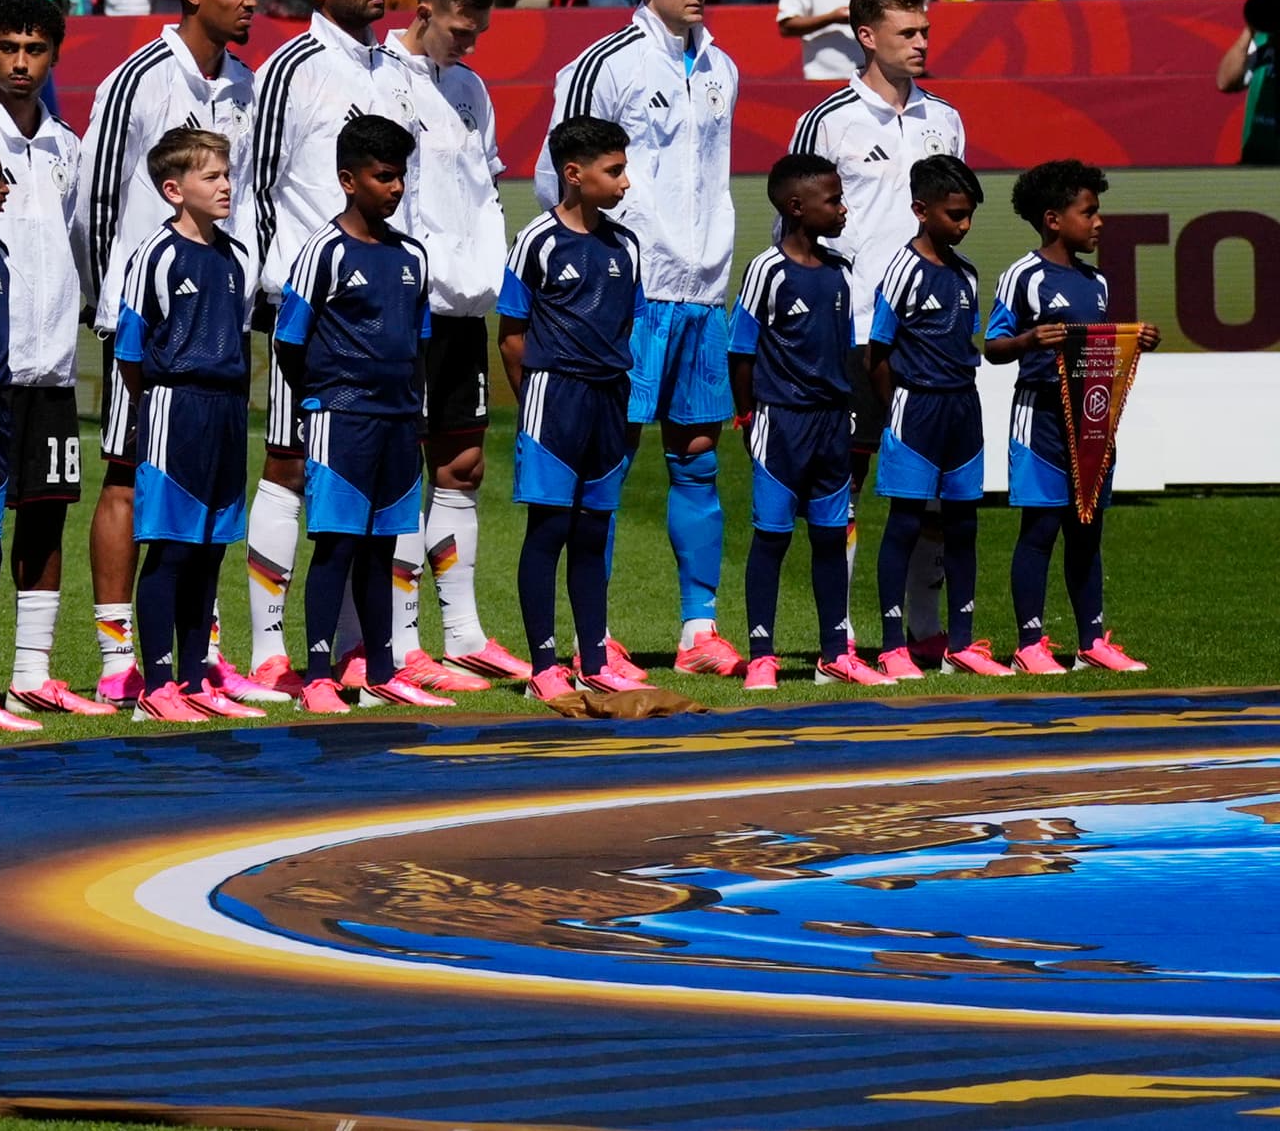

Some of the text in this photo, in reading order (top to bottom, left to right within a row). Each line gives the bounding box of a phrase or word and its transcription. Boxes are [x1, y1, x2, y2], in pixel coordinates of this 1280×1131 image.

[46, 436, 80, 483] 18
[268, 604, 285, 614] DF
[404, 601, 420, 611] DF
